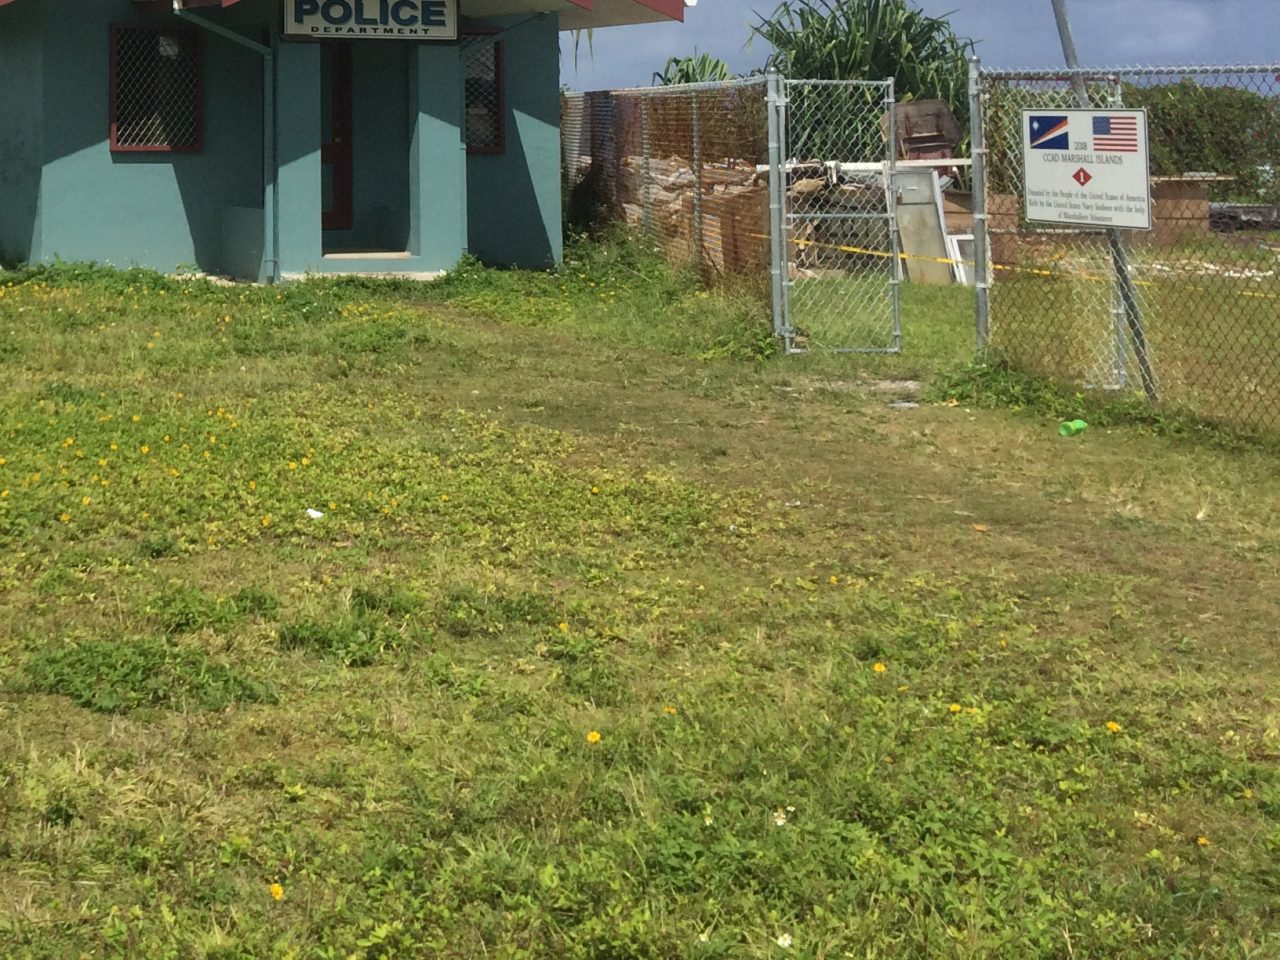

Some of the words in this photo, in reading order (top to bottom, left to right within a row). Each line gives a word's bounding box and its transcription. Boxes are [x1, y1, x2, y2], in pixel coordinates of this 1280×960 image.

[311, 26, 430, 35] DEPARTMENT
[1061, 154, 1094, 164] MARSHALL
[1096, 155, 1123, 166] ISLANDS
